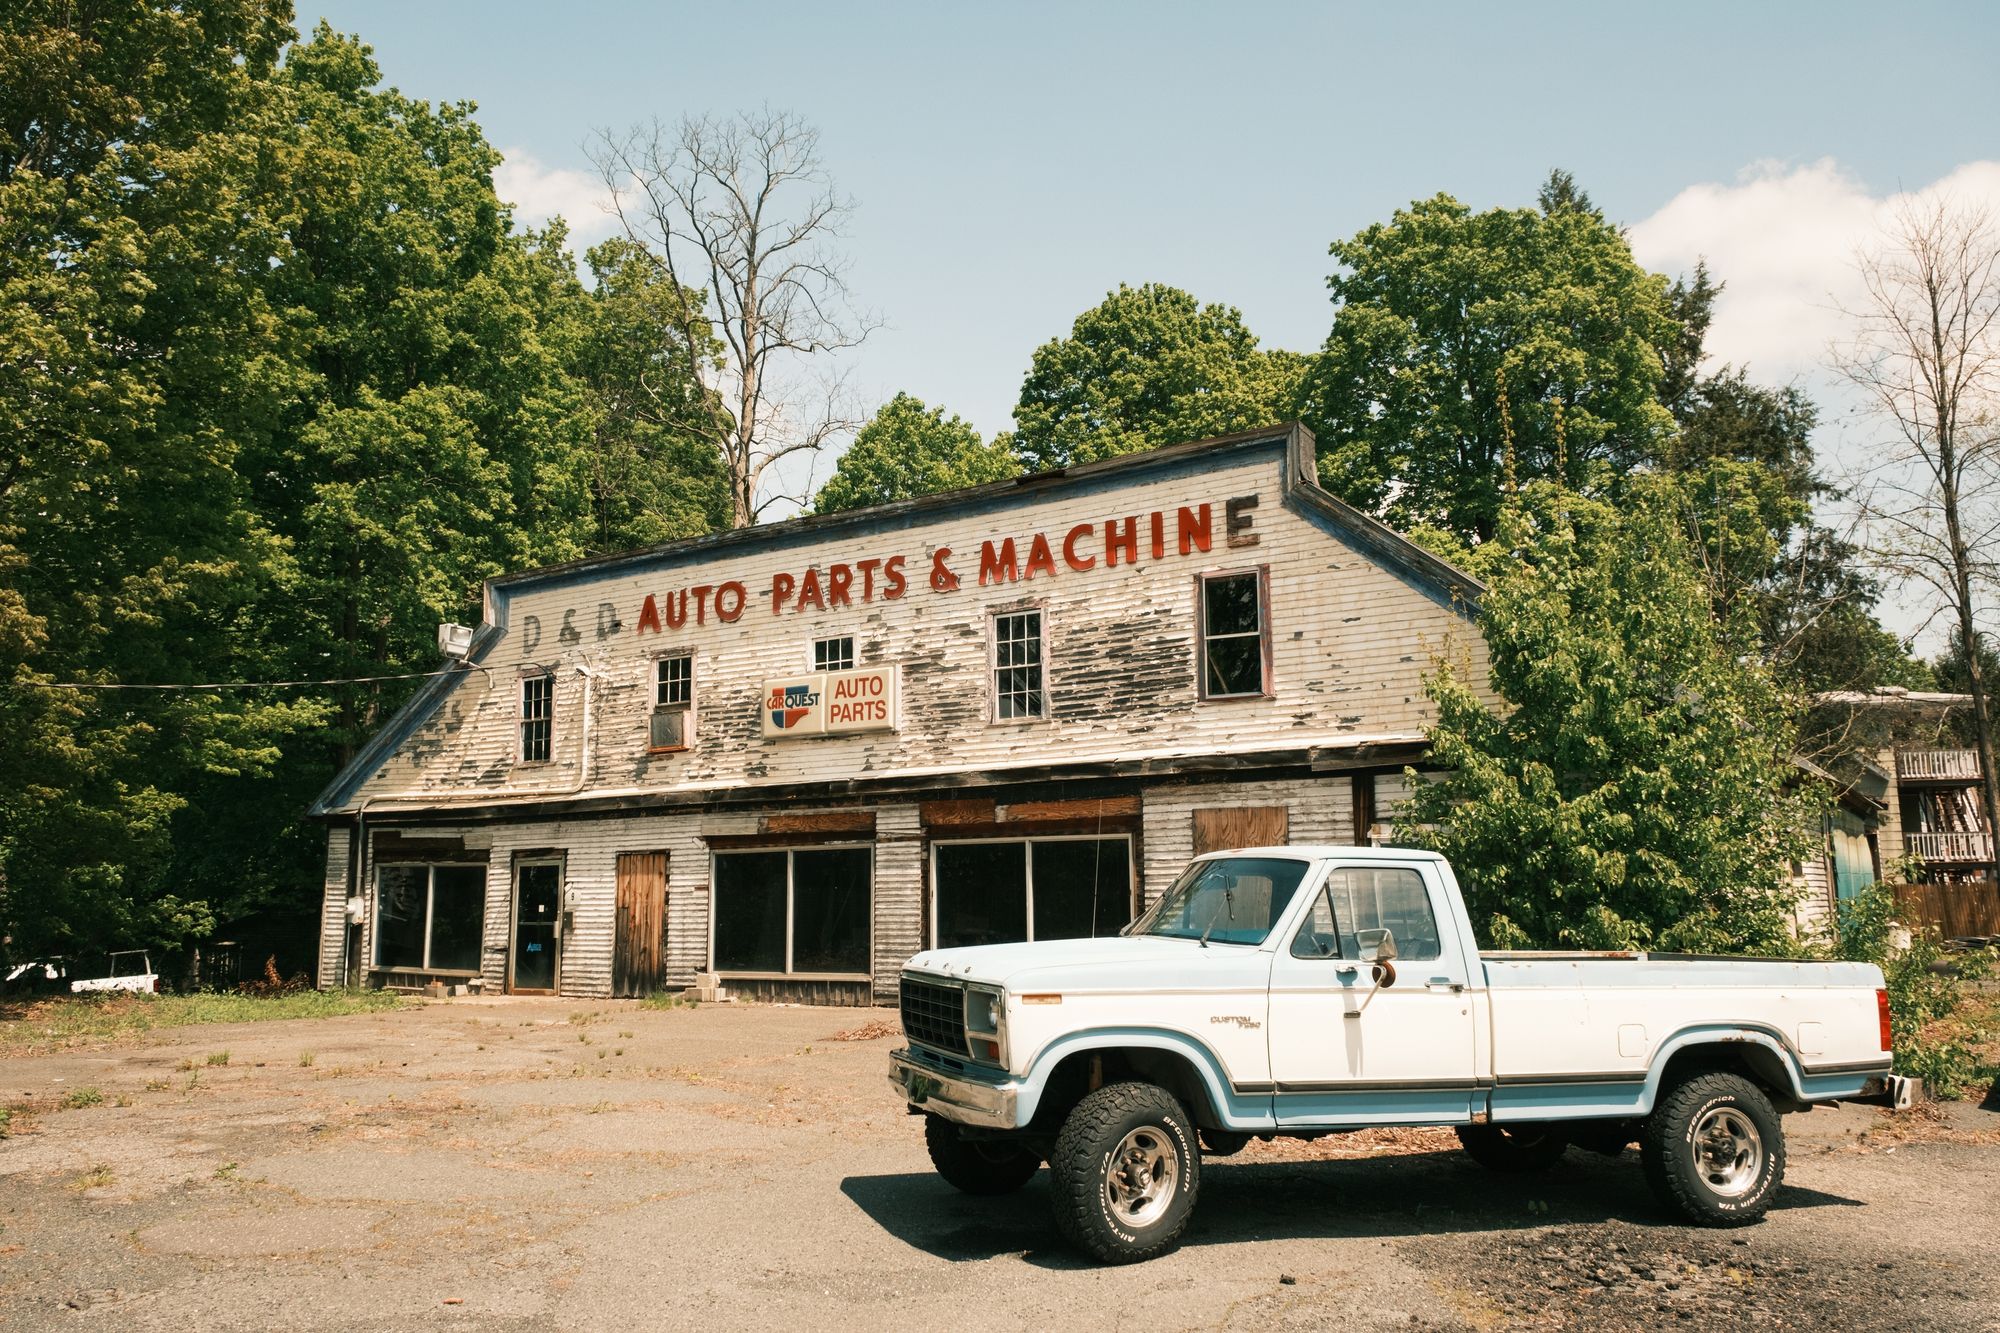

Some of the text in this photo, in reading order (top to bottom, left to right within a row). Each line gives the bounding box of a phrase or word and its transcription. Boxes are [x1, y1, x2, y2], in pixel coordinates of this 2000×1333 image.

[523, 614, 541, 658] D
[557, 608, 581, 647] &
[636, 580, 748, 637] AUTO
[772, 555, 909, 616] PARTS
[929, 547, 961, 593] &
[978, 493, 1261, 587] MACHINE
[835, 676, 883, 699] AUTO
[830, 700, 887, 723] PARTS
